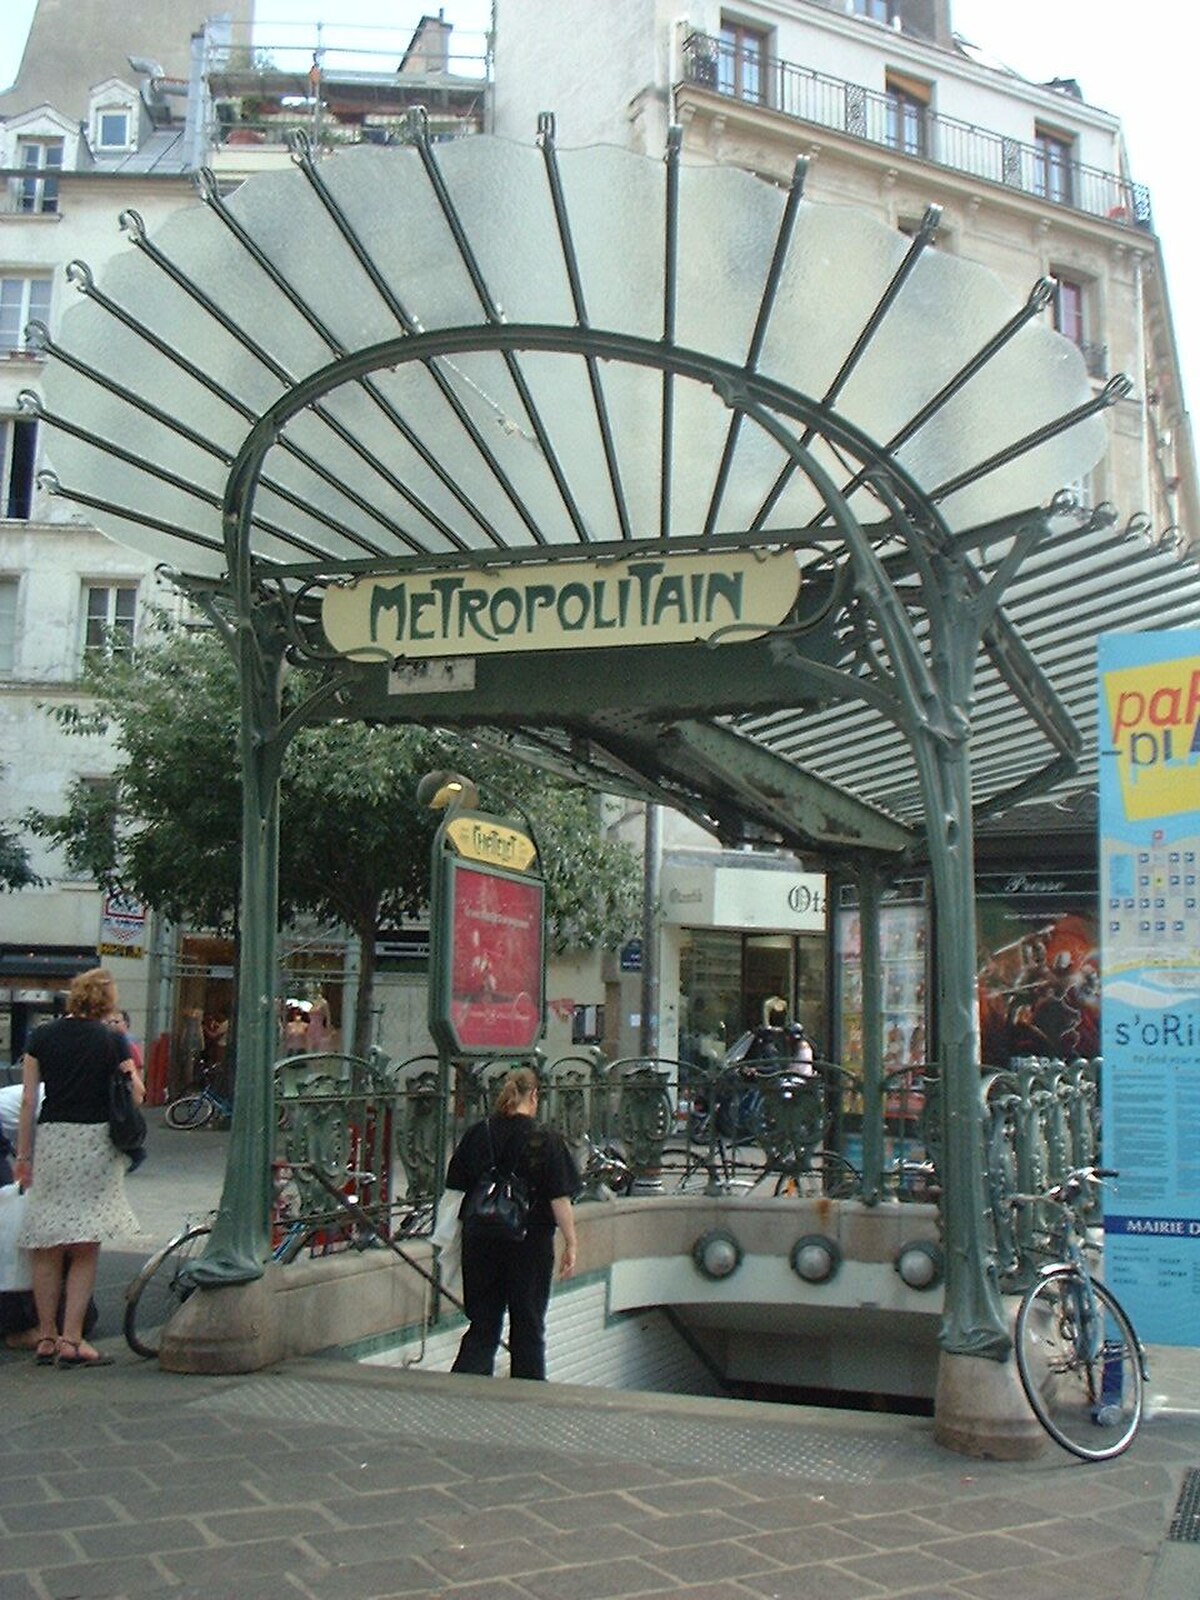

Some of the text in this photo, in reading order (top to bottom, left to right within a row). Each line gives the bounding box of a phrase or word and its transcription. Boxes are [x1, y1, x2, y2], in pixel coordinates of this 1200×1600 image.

[369, 562, 744, 642] METROPOLITAIN
[1115, 1013, 1200, 1046] s'oRi
[1126, 1220, 1185, 1234] MAIRIE
